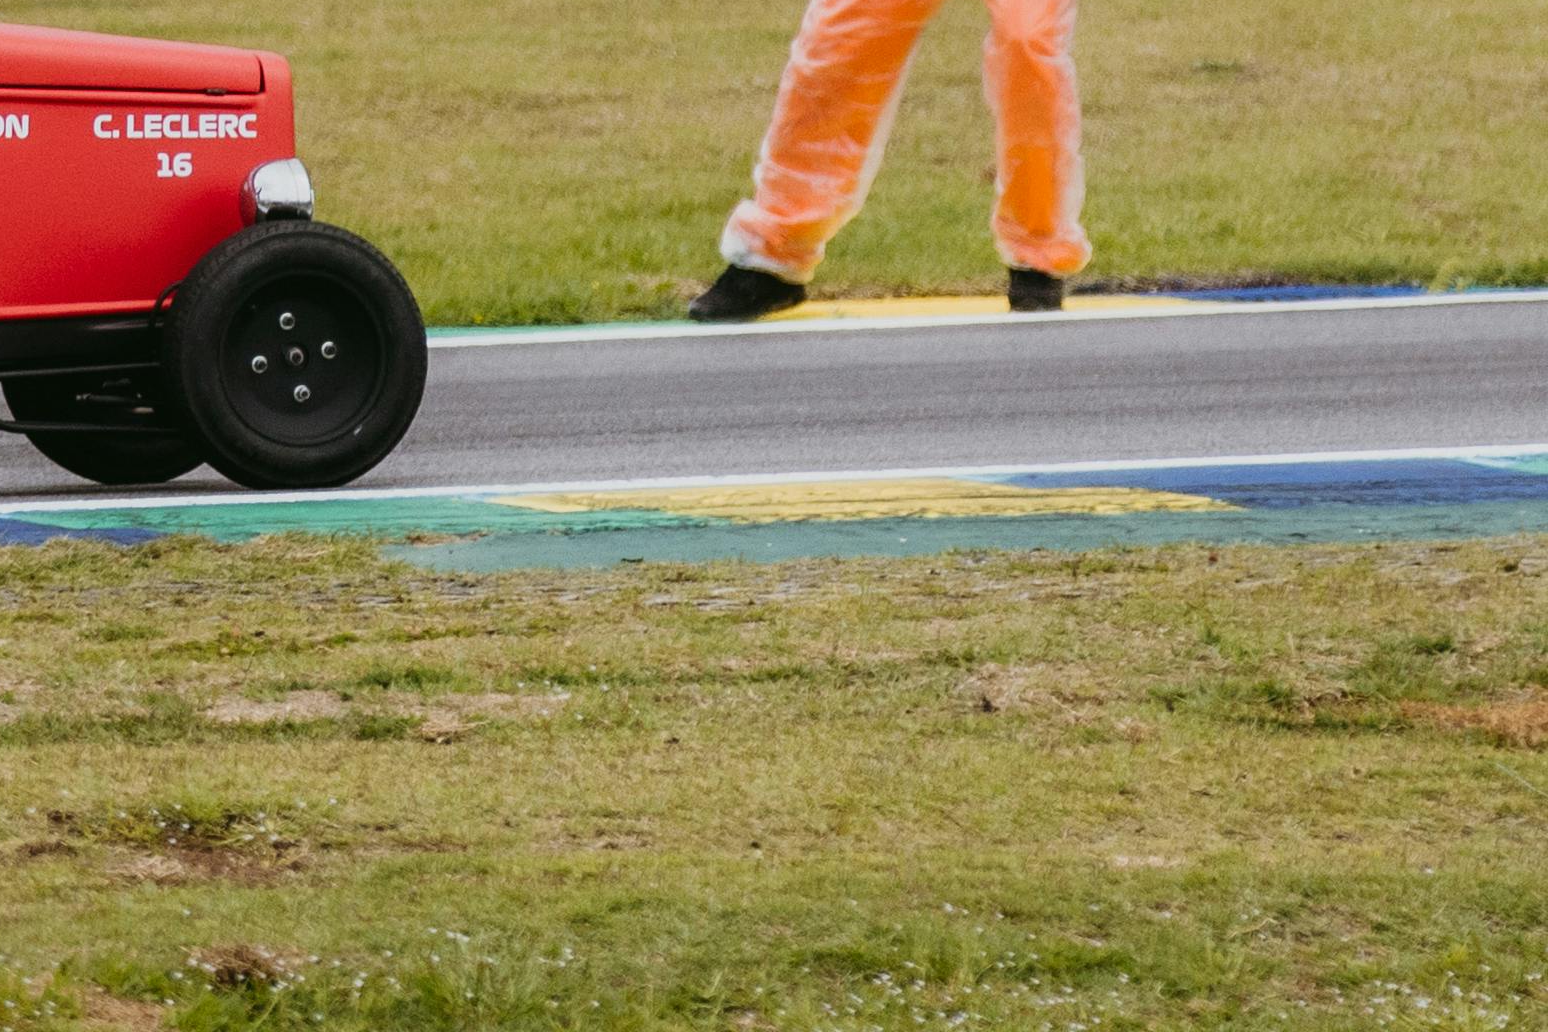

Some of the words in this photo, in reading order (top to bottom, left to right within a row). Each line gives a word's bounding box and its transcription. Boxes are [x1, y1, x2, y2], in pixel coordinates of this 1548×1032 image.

[93, 113, 120, 138] C.
[126, 113, 257, 139] LECLERC
[156, 152, 193, 177] 16
